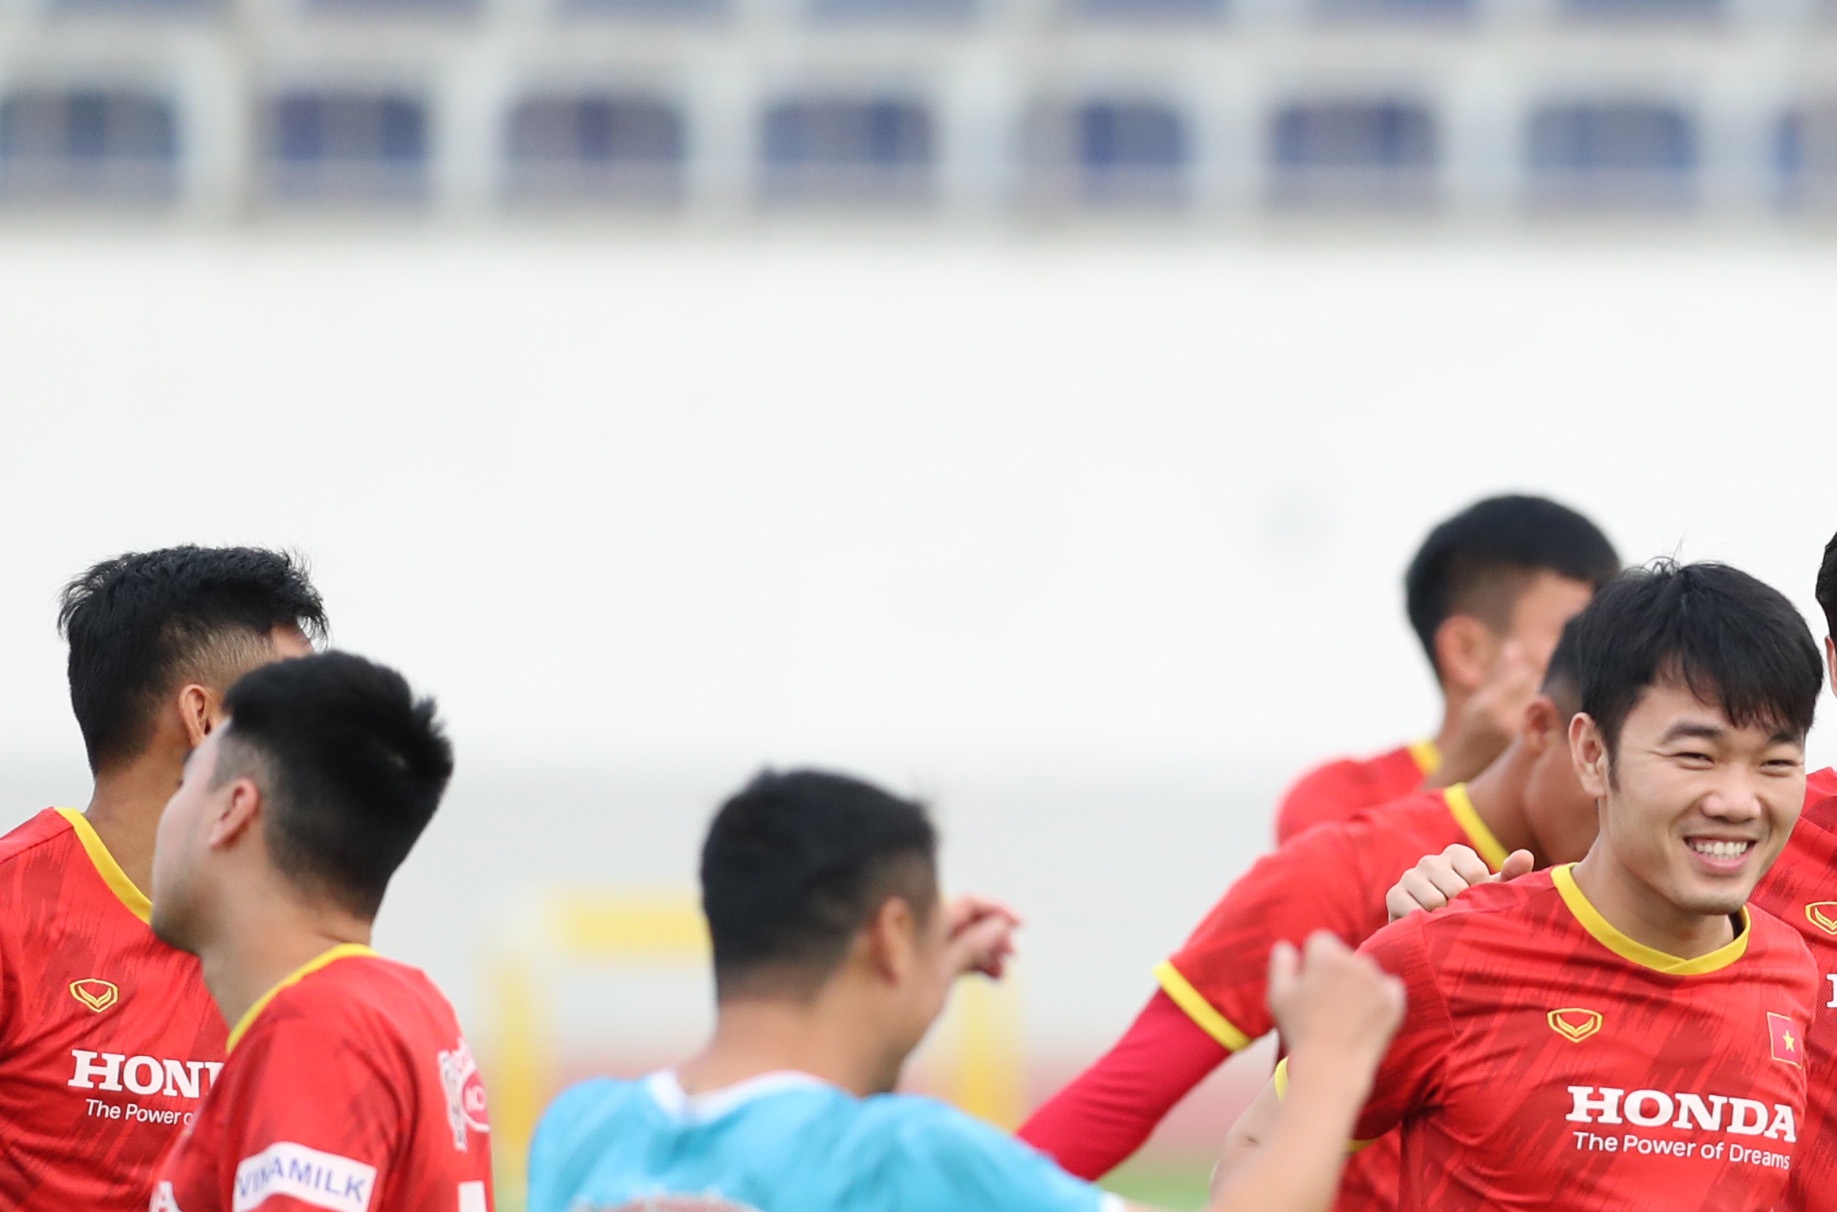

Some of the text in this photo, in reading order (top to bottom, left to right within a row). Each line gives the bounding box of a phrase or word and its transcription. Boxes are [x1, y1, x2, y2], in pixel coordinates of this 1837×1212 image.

[67, 1049, 225, 1099] HON
[85, 1098, 122, 1121] The
[125, 1103, 182, 1126] Power
[1565, 1085, 1797, 1143] HONDA
[1572, 1131, 1791, 1170] The Power of Dreams
